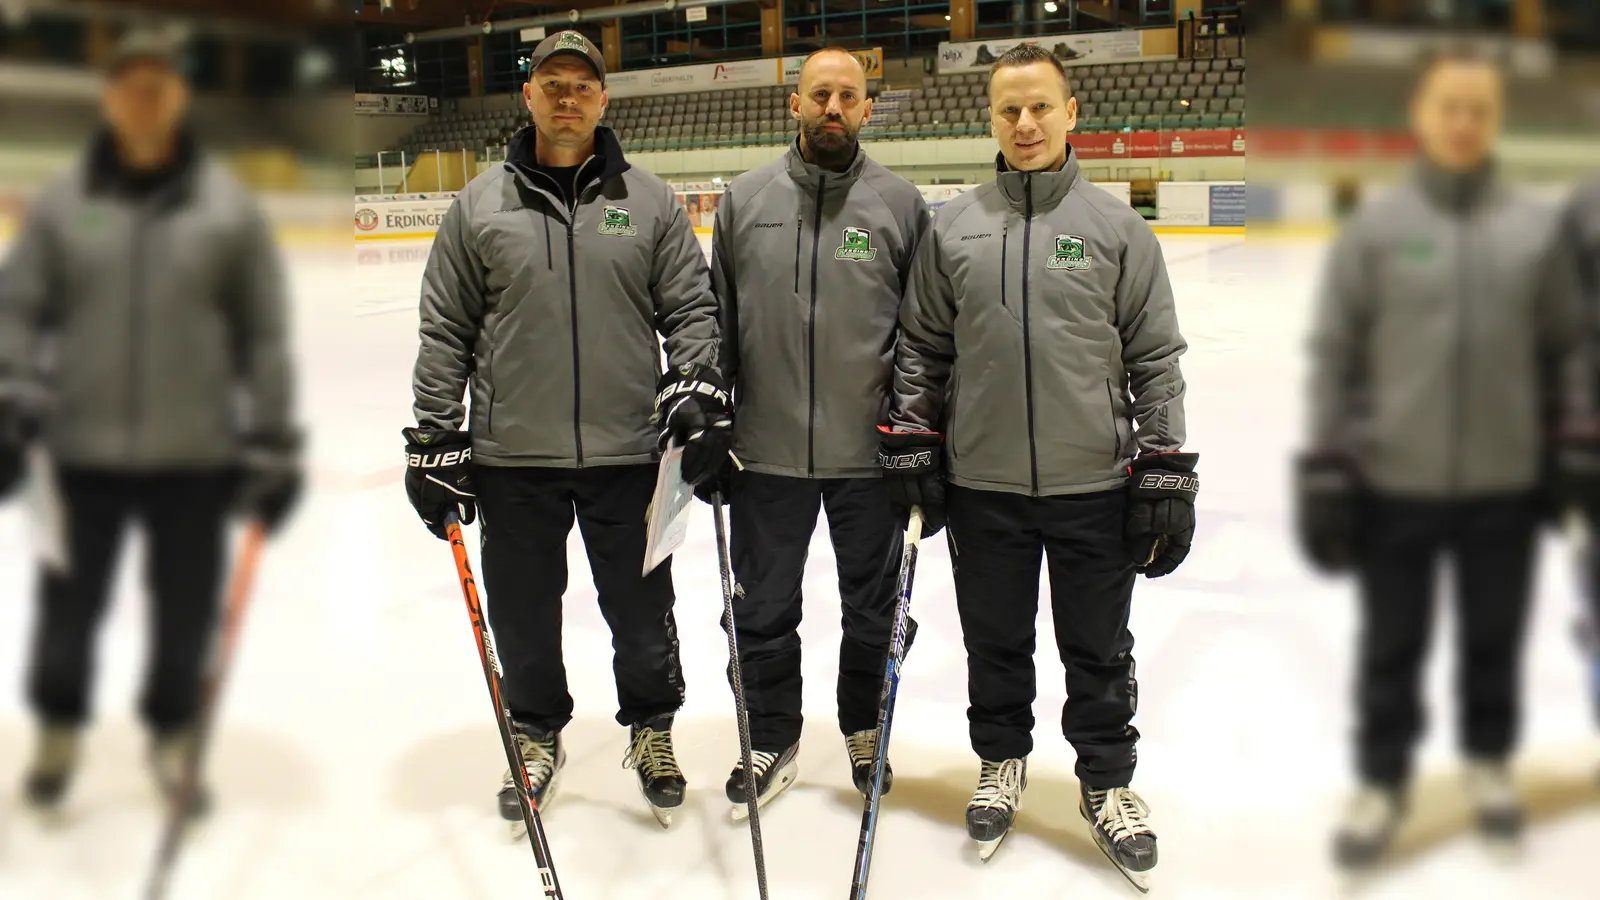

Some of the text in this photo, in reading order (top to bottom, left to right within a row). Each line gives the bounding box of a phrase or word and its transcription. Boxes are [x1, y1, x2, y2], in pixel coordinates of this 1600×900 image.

[386, 213, 445, 229] ERDINGE
[879, 450, 931, 469] UER
[1139, 474, 1200, 494] BAUE
[894, 596, 911, 677] BAUER
